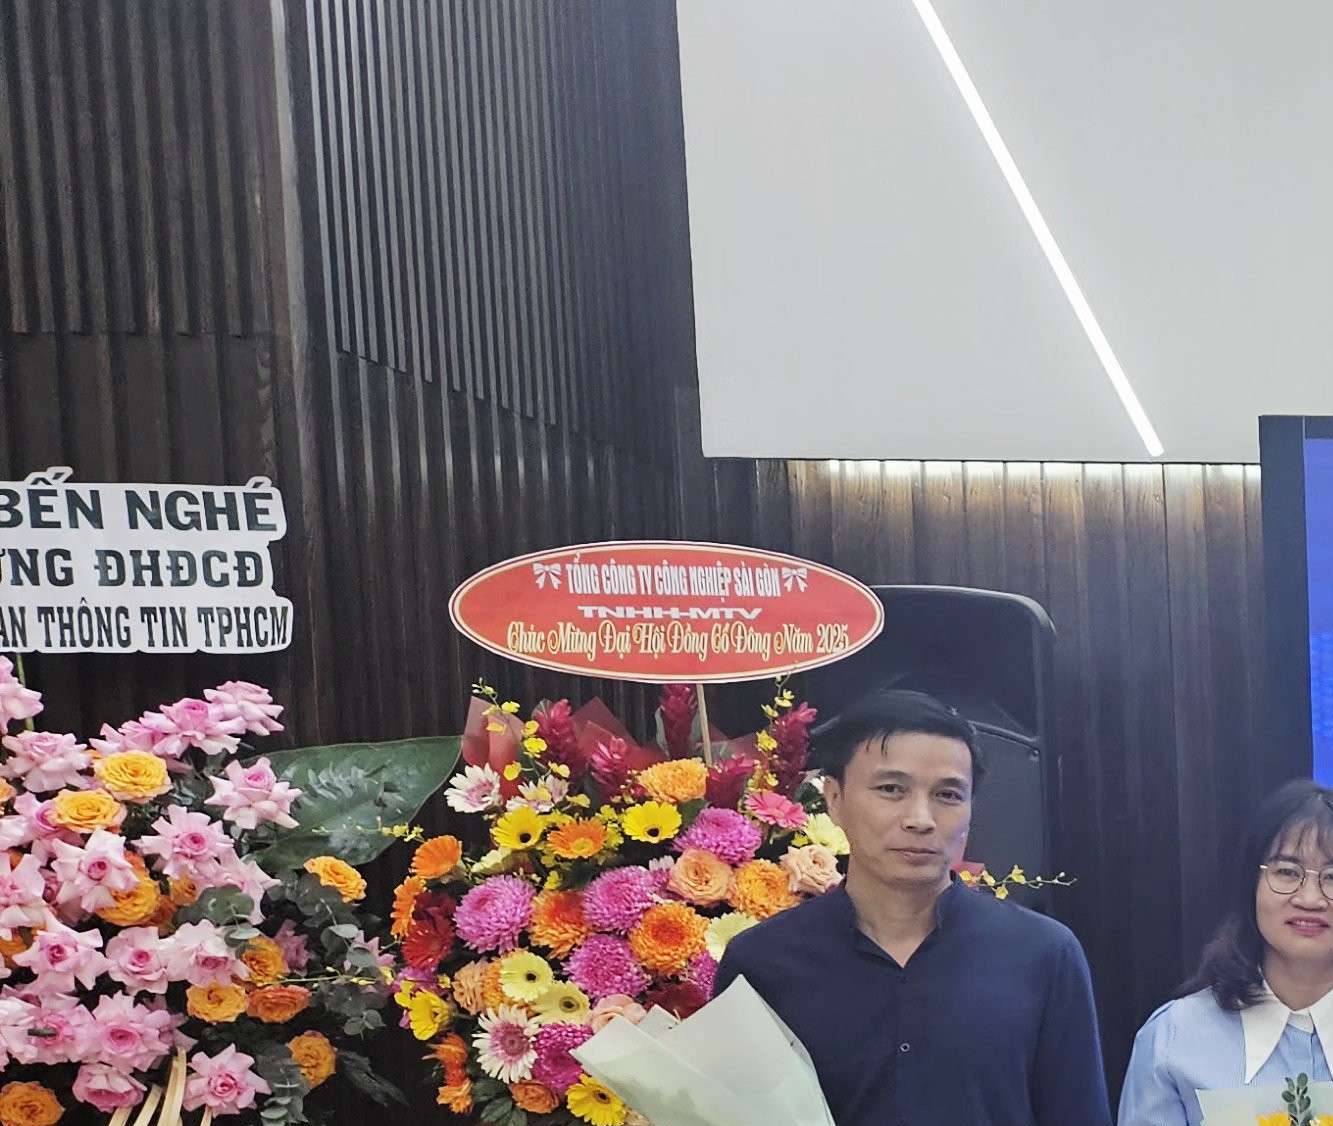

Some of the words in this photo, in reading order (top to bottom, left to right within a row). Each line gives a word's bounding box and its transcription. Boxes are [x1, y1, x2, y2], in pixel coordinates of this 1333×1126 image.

[0, 472, 104, 529] BẾN
[125, 481, 278, 531] NGHÉ
[0, 547, 74, 587] NG
[93, 549, 264, 588] ĐHĐCĐ
[565, 551, 601, 595] TỔNG
[601, 558, 637, 595] CÔNG
[637, 564, 652, 595] TY
[653, 559, 689, 596] CÔNG
[688, 560, 732, 603] NGHIỆP
[733, 560, 755, 597] SÀI
[755, 563, 782, 598] GÒN
[37, 597, 132, 648] THÔNG
[140, 606, 189, 648] TIN
[197, 606, 289, 648] TPHCM
[577, 605, 763, 620] TNHH-MTV
[507, 621, 547, 655] Chúc
[598, 619, 632, 659] Đại
[632, 622, 667, 659] Hội
[667, 620, 708, 662] Đồng
[730, 620, 771, 662] Đông
[773, 623, 814, 655] Năm
[816, 622, 850, 654] 2025
